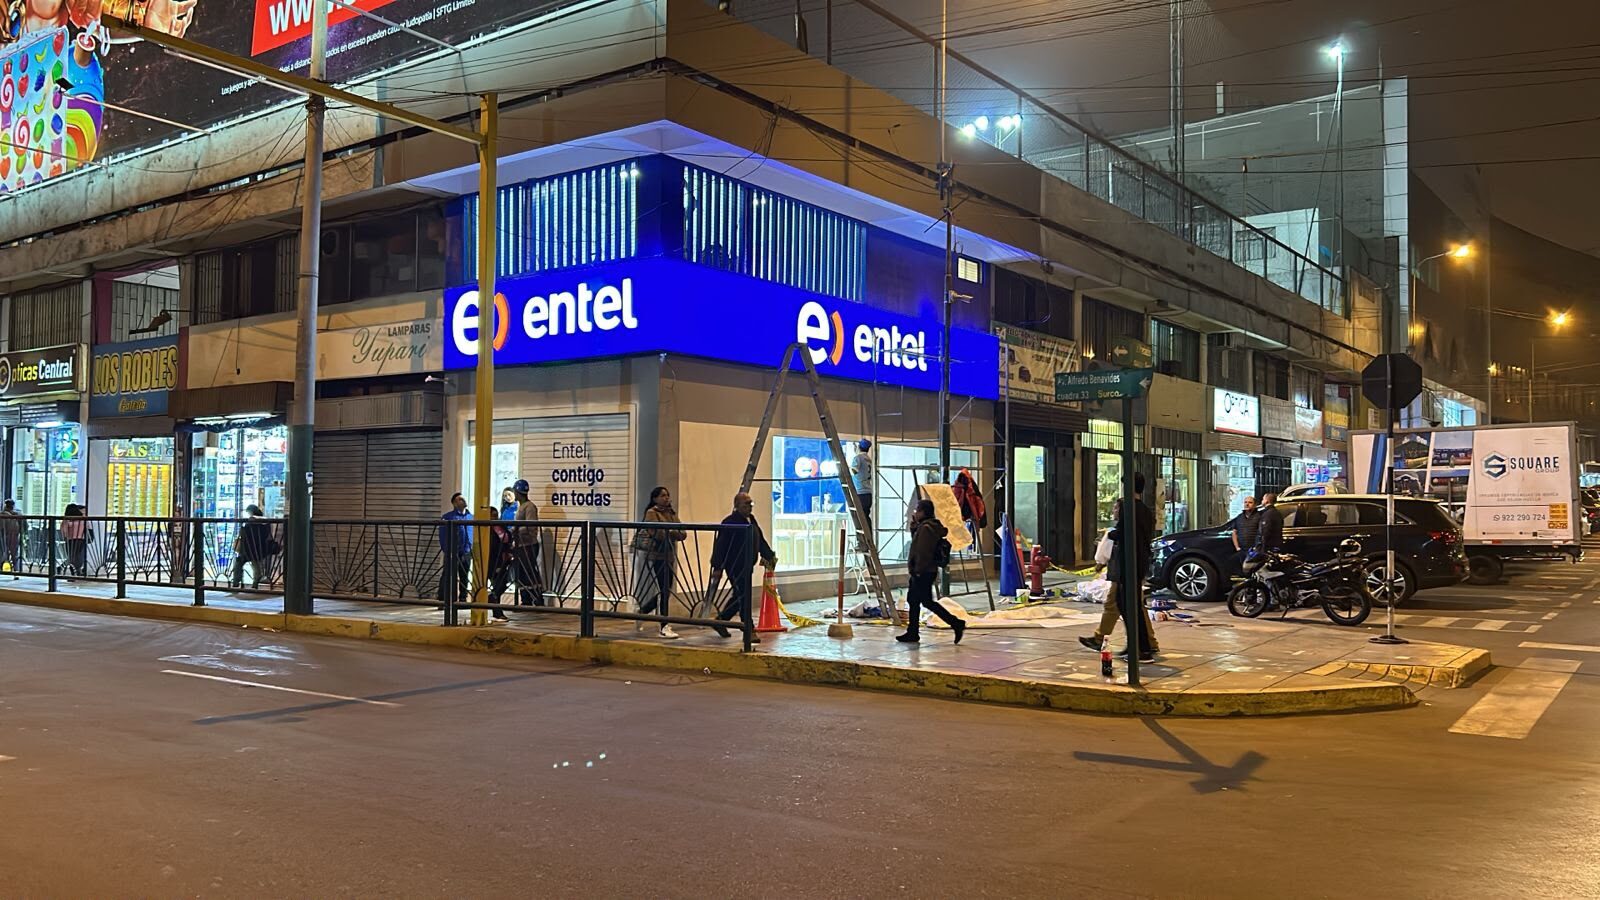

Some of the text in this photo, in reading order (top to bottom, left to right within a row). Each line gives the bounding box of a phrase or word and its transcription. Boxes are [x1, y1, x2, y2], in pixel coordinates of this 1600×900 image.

[347, 37, 366, 50] exceso
[366, 28, 387, 45] pueden
[523, 277, 638, 339] entel
[387, 323, 431, 337] LAMPARAS
[854, 324, 928, 372] entel
[38, 355, 73, 380] Central
[92, 344, 178, 397] LOS ROBLES
[1068, 374, 1089, 385] Alfredo
[1089, 374, 1121, 385] Benavides
[1057, 390, 1080, 401] cuadra
[1080, 390, 1090, 400] 33
[1097, 389, 1120, 398] Surco
[552, 441, 590, 460] Entel,
[1510, 456, 1560, 470] SQUARE
[551, 464, 605, 487] contigo
[551, 489, 611, 506] en todas
